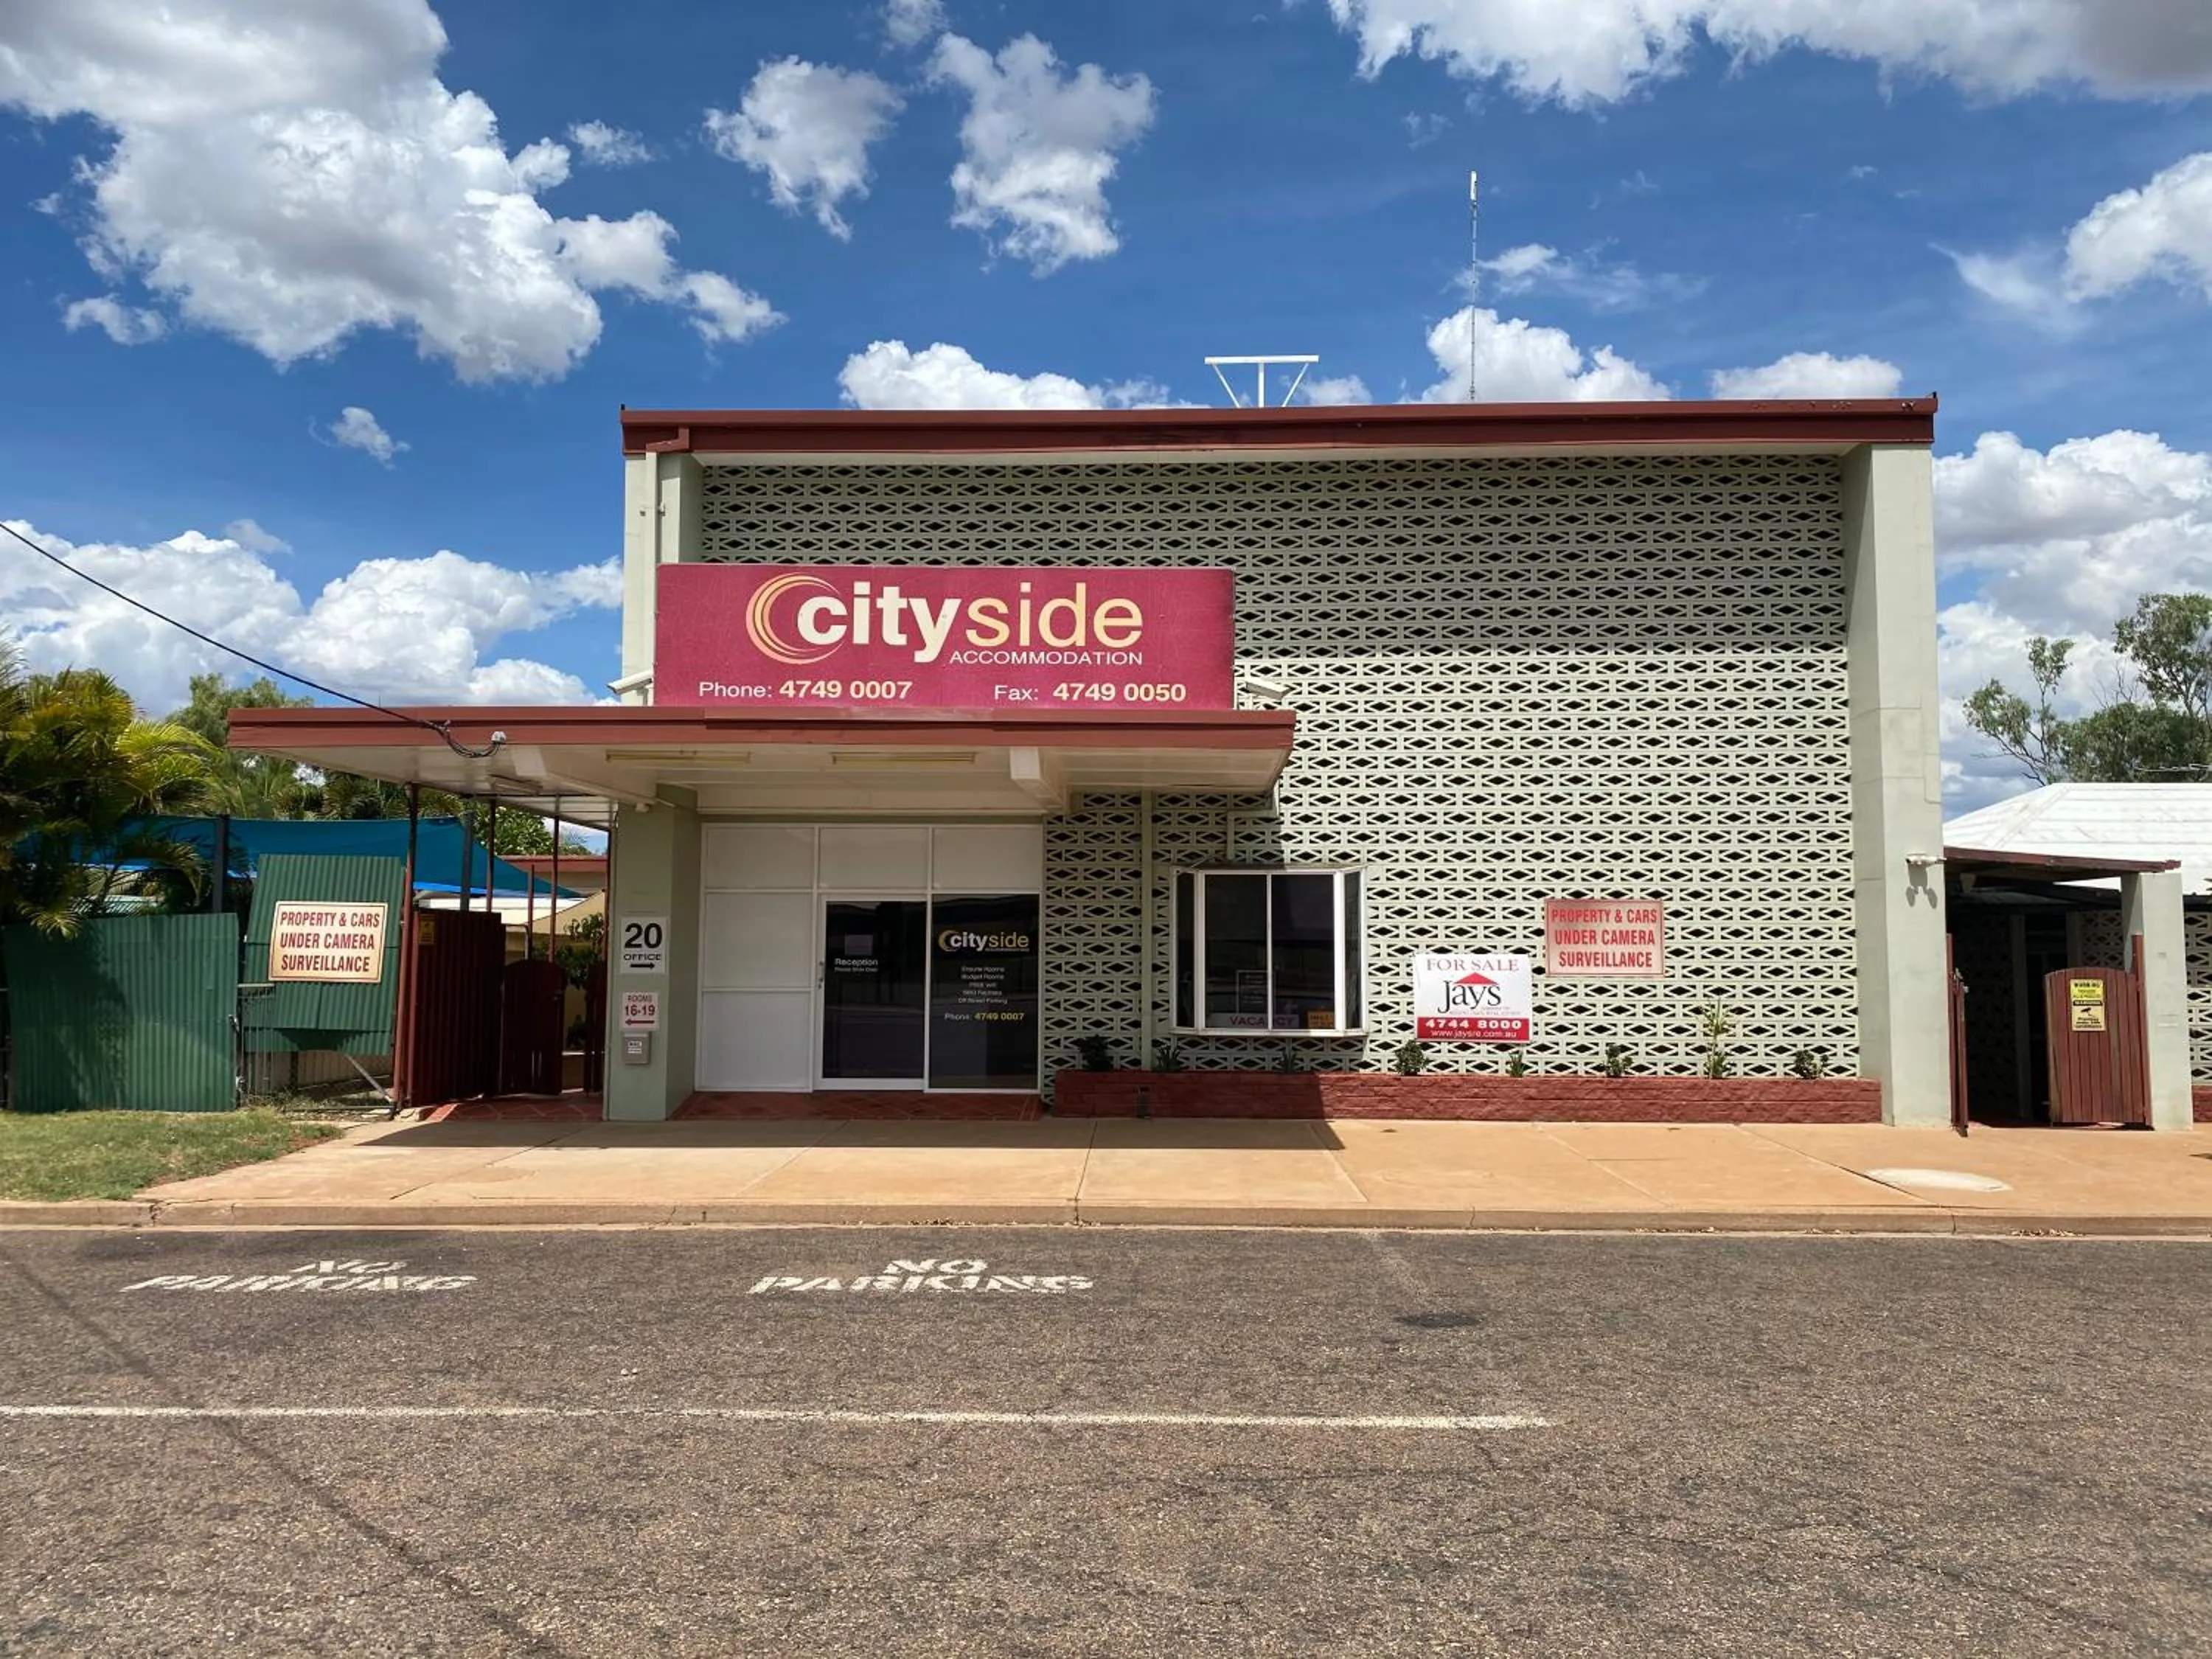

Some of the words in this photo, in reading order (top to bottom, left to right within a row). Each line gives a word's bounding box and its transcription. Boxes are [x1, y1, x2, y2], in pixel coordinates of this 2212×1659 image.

[796, 581, 1143, 663] cityside
[950, 650, 1143, 665] ACCOMMODATION
[699, 681, 772, 698] Phone:
[779, 681, 842, 699] 4749
[849, 681, 912, 699] 0007
[994, 685, 1040, 701] Fax:
[1053, 684, 1117, 701] 4749
[1123, 684, 1186, 702] 0050
[280, 911, 336, 927] PROPERTY
[339, 913, 347, 927] &
[350, 913, 380, 928] CARS
[1551, 909, 1612, 922] PROPERTY
[1615, 909, 1623, 922] &
[1627, 909, 1658, 922] CARS
[280, 933, 320, 948] UNDER
[324, 933, 375, 949] CAMERA
[625, 923, 662, 949] 20
[950, 931, 1029, 951] cityside
[1555, 930, 1597, 945] UNDER
[1601, 930, 1655, 945] CAMERA
[282, 956, 369, 972] SURVEILLANCE
[835, 959, 878, 967] Reception
[1427, 959, 1470, 971] FOR
[1475, 959, 1519, 971] SALE
[1559, 952, 1652, 967] SURVEILLANCE
[1438, 981, 1501, 1013] Jays
[975, 1012, 998, 1020] 4749
[1001, 1012, 1025, 1020] 0007
[1230, 1017, 1294, 1026] VACACY
[1425, 1019, 1469, 1028] 4744
[1477, 1020, 1522, 1029] 8000
[883, 1259, 991, 1274] NO
[746, 1275, 1094, 1293] PARKING
